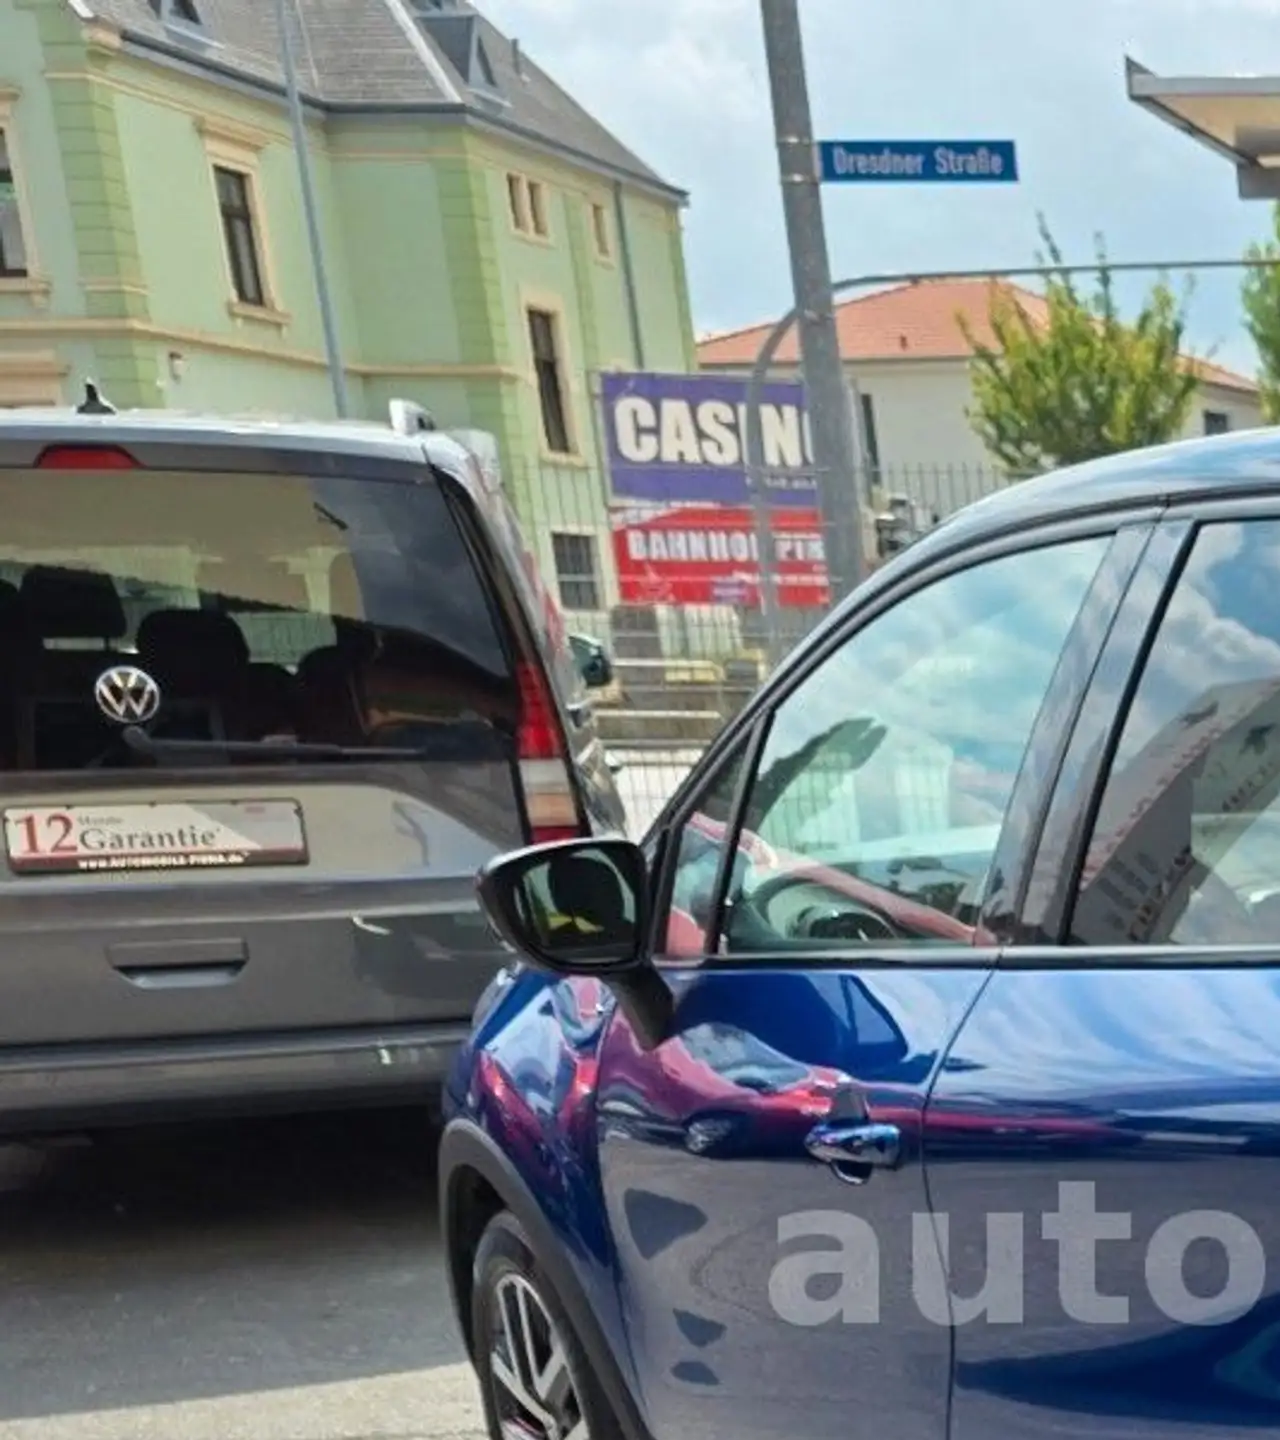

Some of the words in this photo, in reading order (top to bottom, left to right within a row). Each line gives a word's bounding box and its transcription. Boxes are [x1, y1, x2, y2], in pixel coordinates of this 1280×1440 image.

[832, 147, 925, 175] Dresdner
[934, 147, 1003, 175] Straße
[614, 396, 815, 467] CASIN
[16, 813, 78, 854] 12
[79, 824, 216, 851] Garantie
